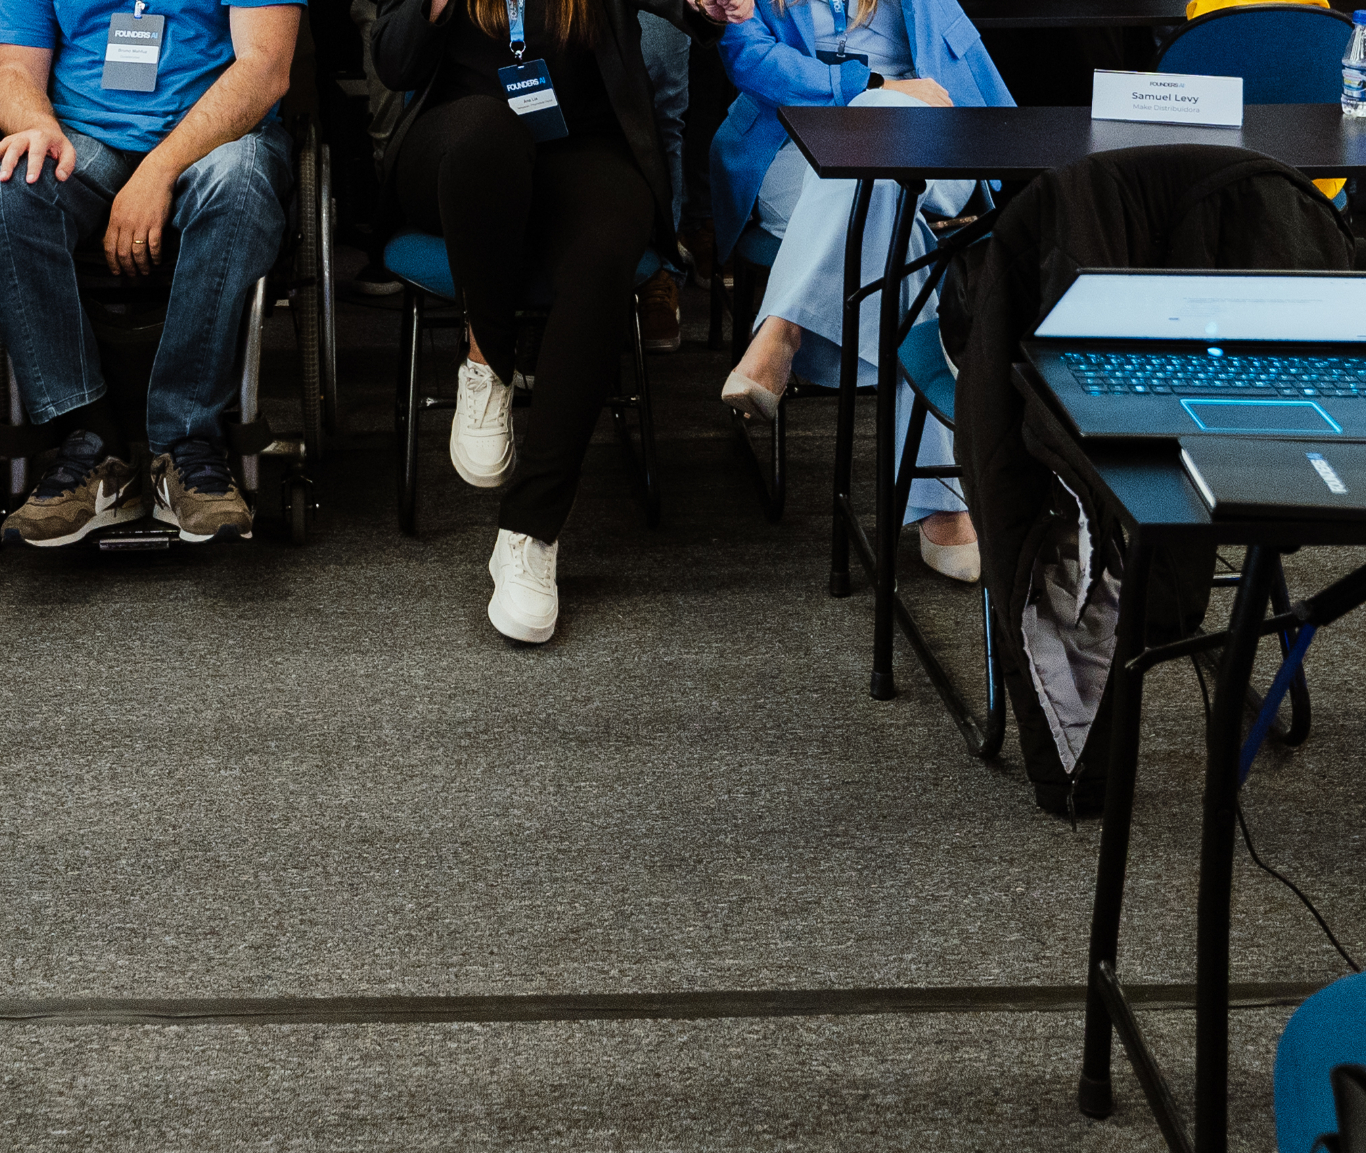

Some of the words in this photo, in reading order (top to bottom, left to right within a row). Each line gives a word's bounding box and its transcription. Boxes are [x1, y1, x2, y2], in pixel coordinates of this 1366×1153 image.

[115, 30, 151, 39] FOUNDERS
[151, 31, 158, 39] AI
[507, 78, 539, 92] FOUNDERS
[1132, 91, 1171, 101] Samuel
[1175, 93, 1199, 104] Levy
[1133, 103, 1152, 111] Make
[1153, 104, 1200, 113] Distribuidora
